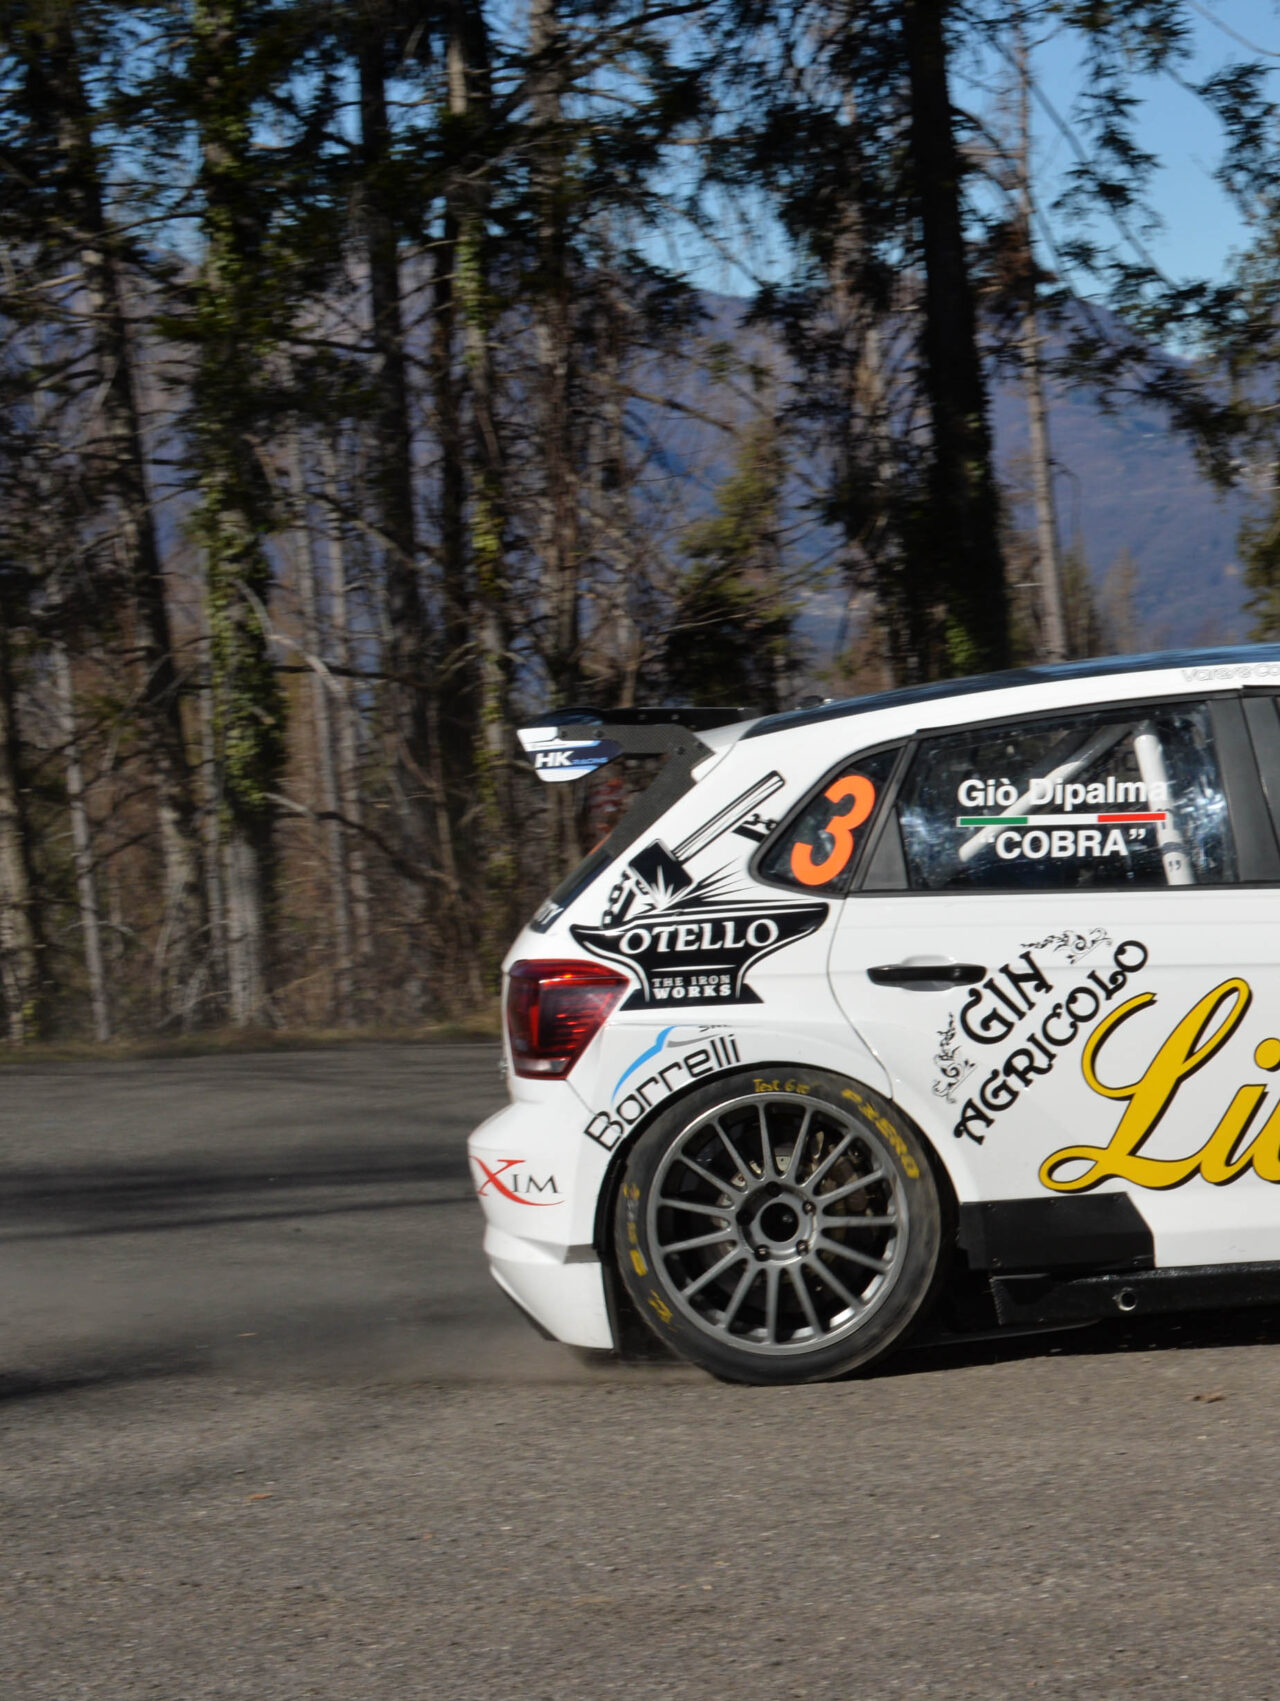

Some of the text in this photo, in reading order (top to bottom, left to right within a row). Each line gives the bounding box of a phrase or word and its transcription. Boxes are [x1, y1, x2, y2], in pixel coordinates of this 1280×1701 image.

[534, 750, 574, 768] HK
[957, 776, 1169, 811] Giò Dipalma
[790, 774, 876, 886] 3
[619, 919, 779, 954] OTELLO
[651, 974, 731, 987] THE IRON
[652, 984, 732, 999] WORKS
[960, 951, 1054, 1045] GIN
[953, 939, 1149, 1146] AGRICOLO
[468, 1154, 566, 1207] XIM
